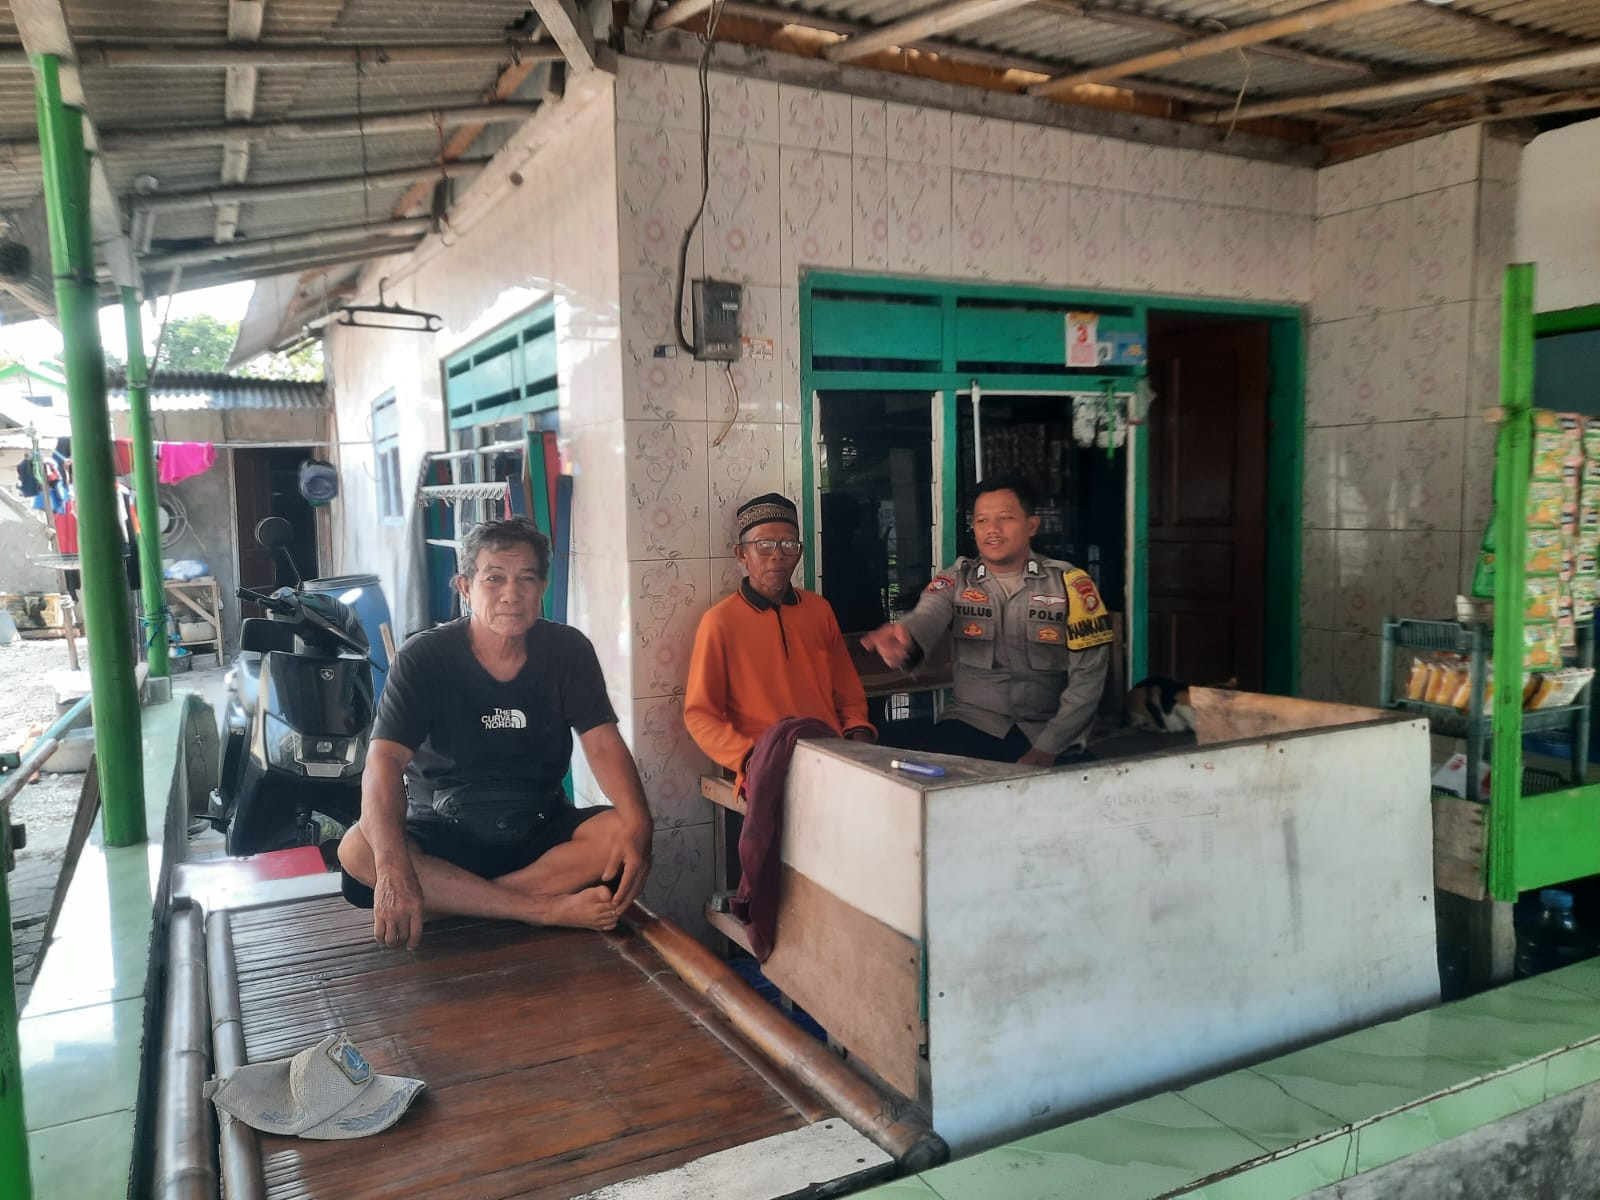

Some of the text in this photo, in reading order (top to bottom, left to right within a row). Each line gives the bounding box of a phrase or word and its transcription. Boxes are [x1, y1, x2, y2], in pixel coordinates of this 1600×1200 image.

[955, 605, 992, 617] TULUS
[1029, 609, 1066, 622] POLR
[494, 708, 511, 716] THE
[485, 720, 512, 729] NORD
